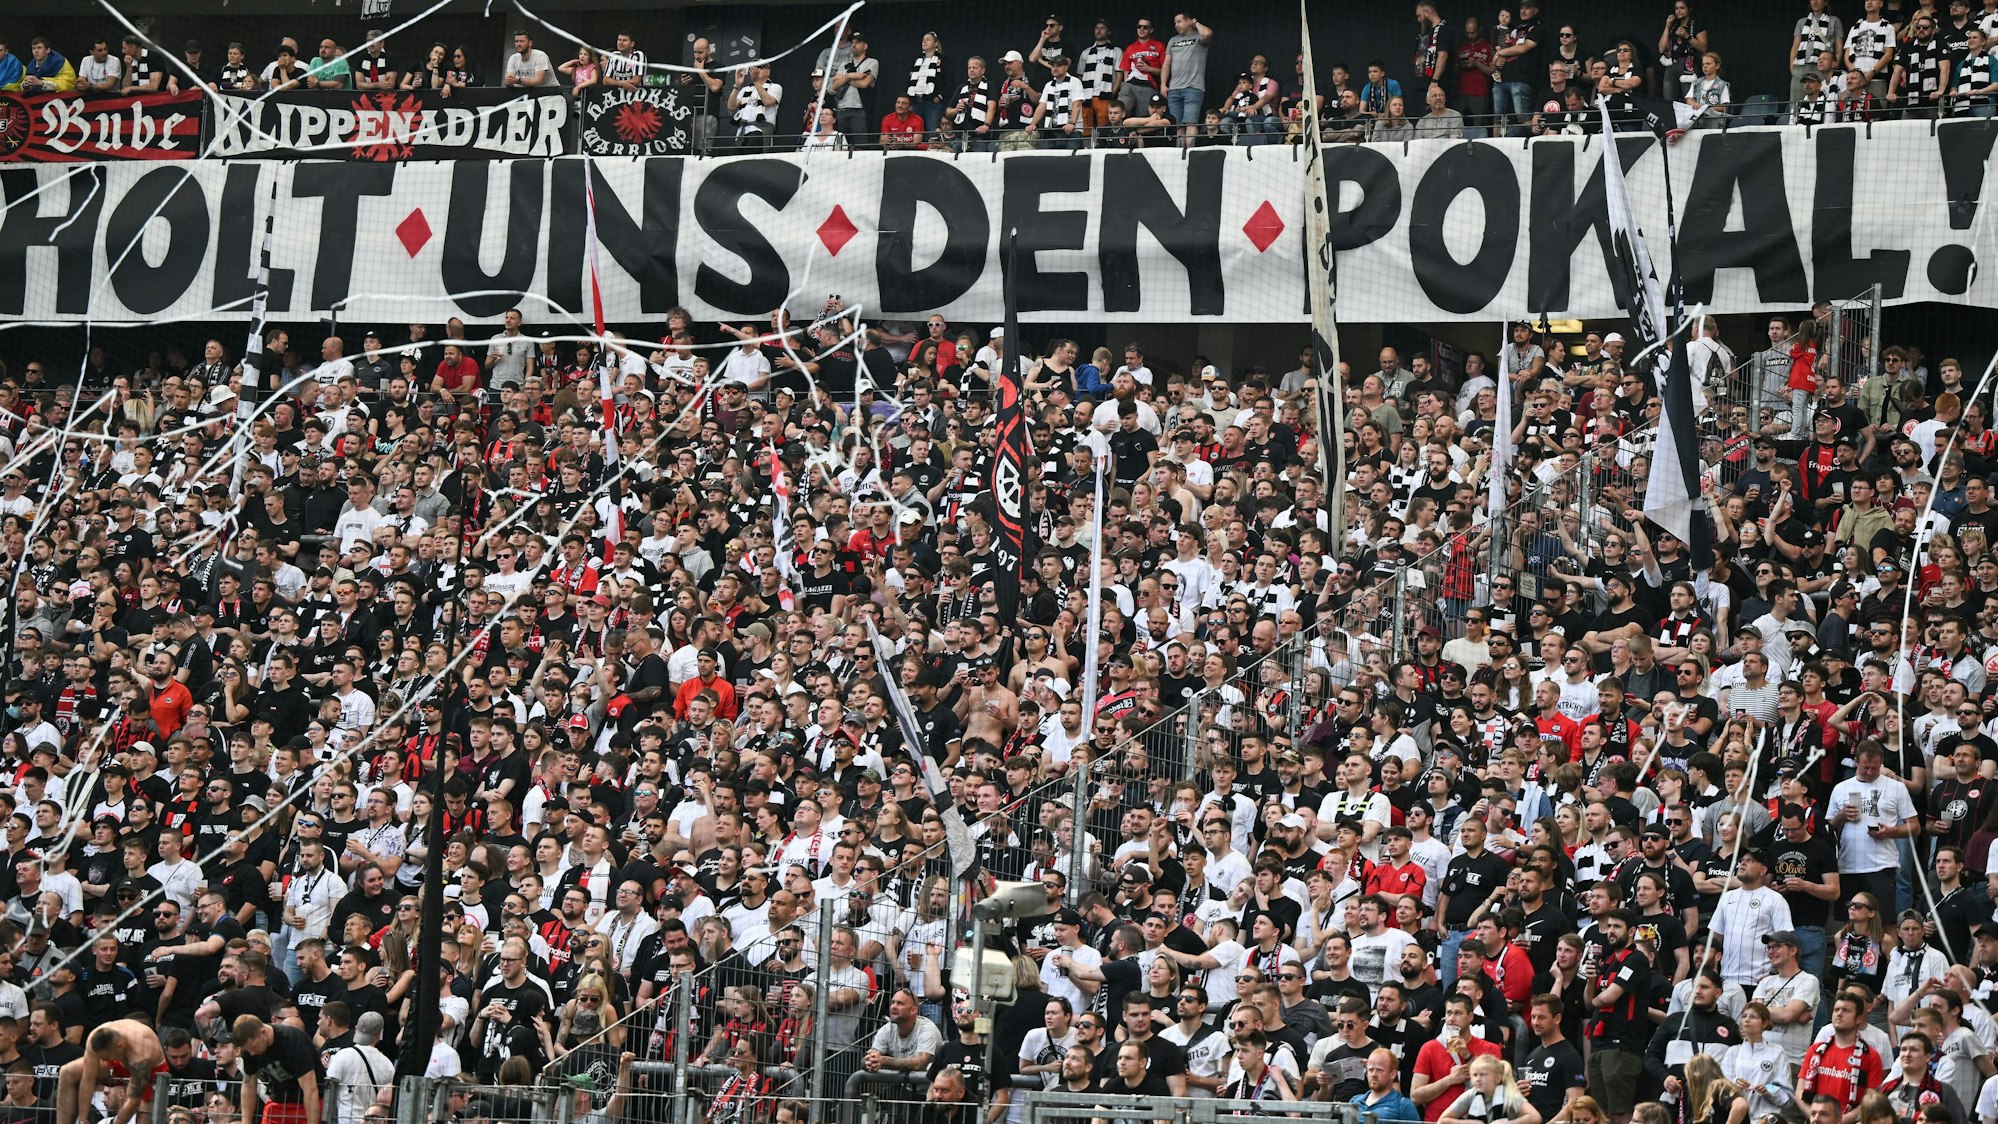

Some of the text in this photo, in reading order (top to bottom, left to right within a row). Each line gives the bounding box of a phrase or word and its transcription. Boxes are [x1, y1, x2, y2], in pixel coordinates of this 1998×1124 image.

[41, 97, 187, 154] Bube
[205, 93, 568, 157] KLIPPENADLER
[0, 161, 396, 315] HOLT
[442, 155, 808, 318] UNS
[877, 149, 1226, 316] DEN
[1303, 118, 1998, 315] POKAL!
[1557, 701, 1584, 714] NTRACHT
[1708, 866, 1731, 877] indee
[1818, 1065, 1852, 1080] rombache
